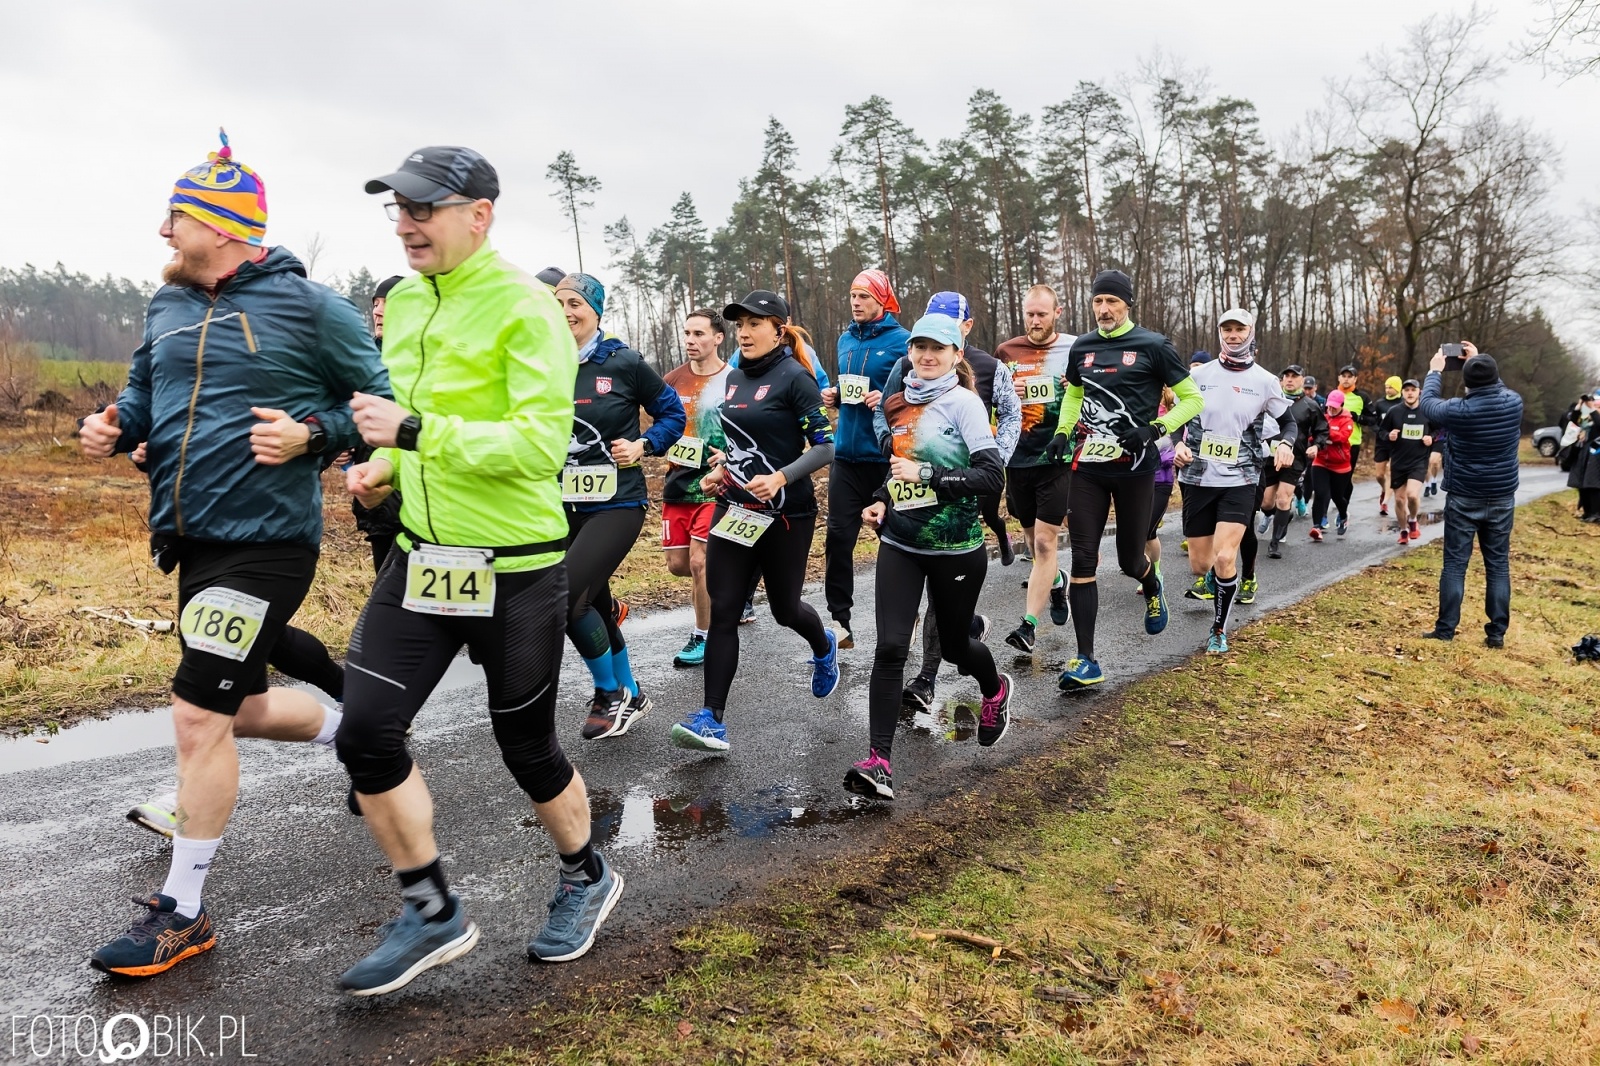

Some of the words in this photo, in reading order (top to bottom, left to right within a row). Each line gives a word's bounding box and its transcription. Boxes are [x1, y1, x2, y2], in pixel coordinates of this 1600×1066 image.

[1406, 429, 1420, 437] 189
[673, 444, 696, 461] 272
[1086, 443, 1116, 458] 222
[1207, 443, 1233, 458] 194
[571, 474, 608, 493] 197
[894, 482, 926, 502] 255
[726, 519, 758, 539] 193
[420, 568, 480, 601] 214
[193, 606, 246, 643] 186
